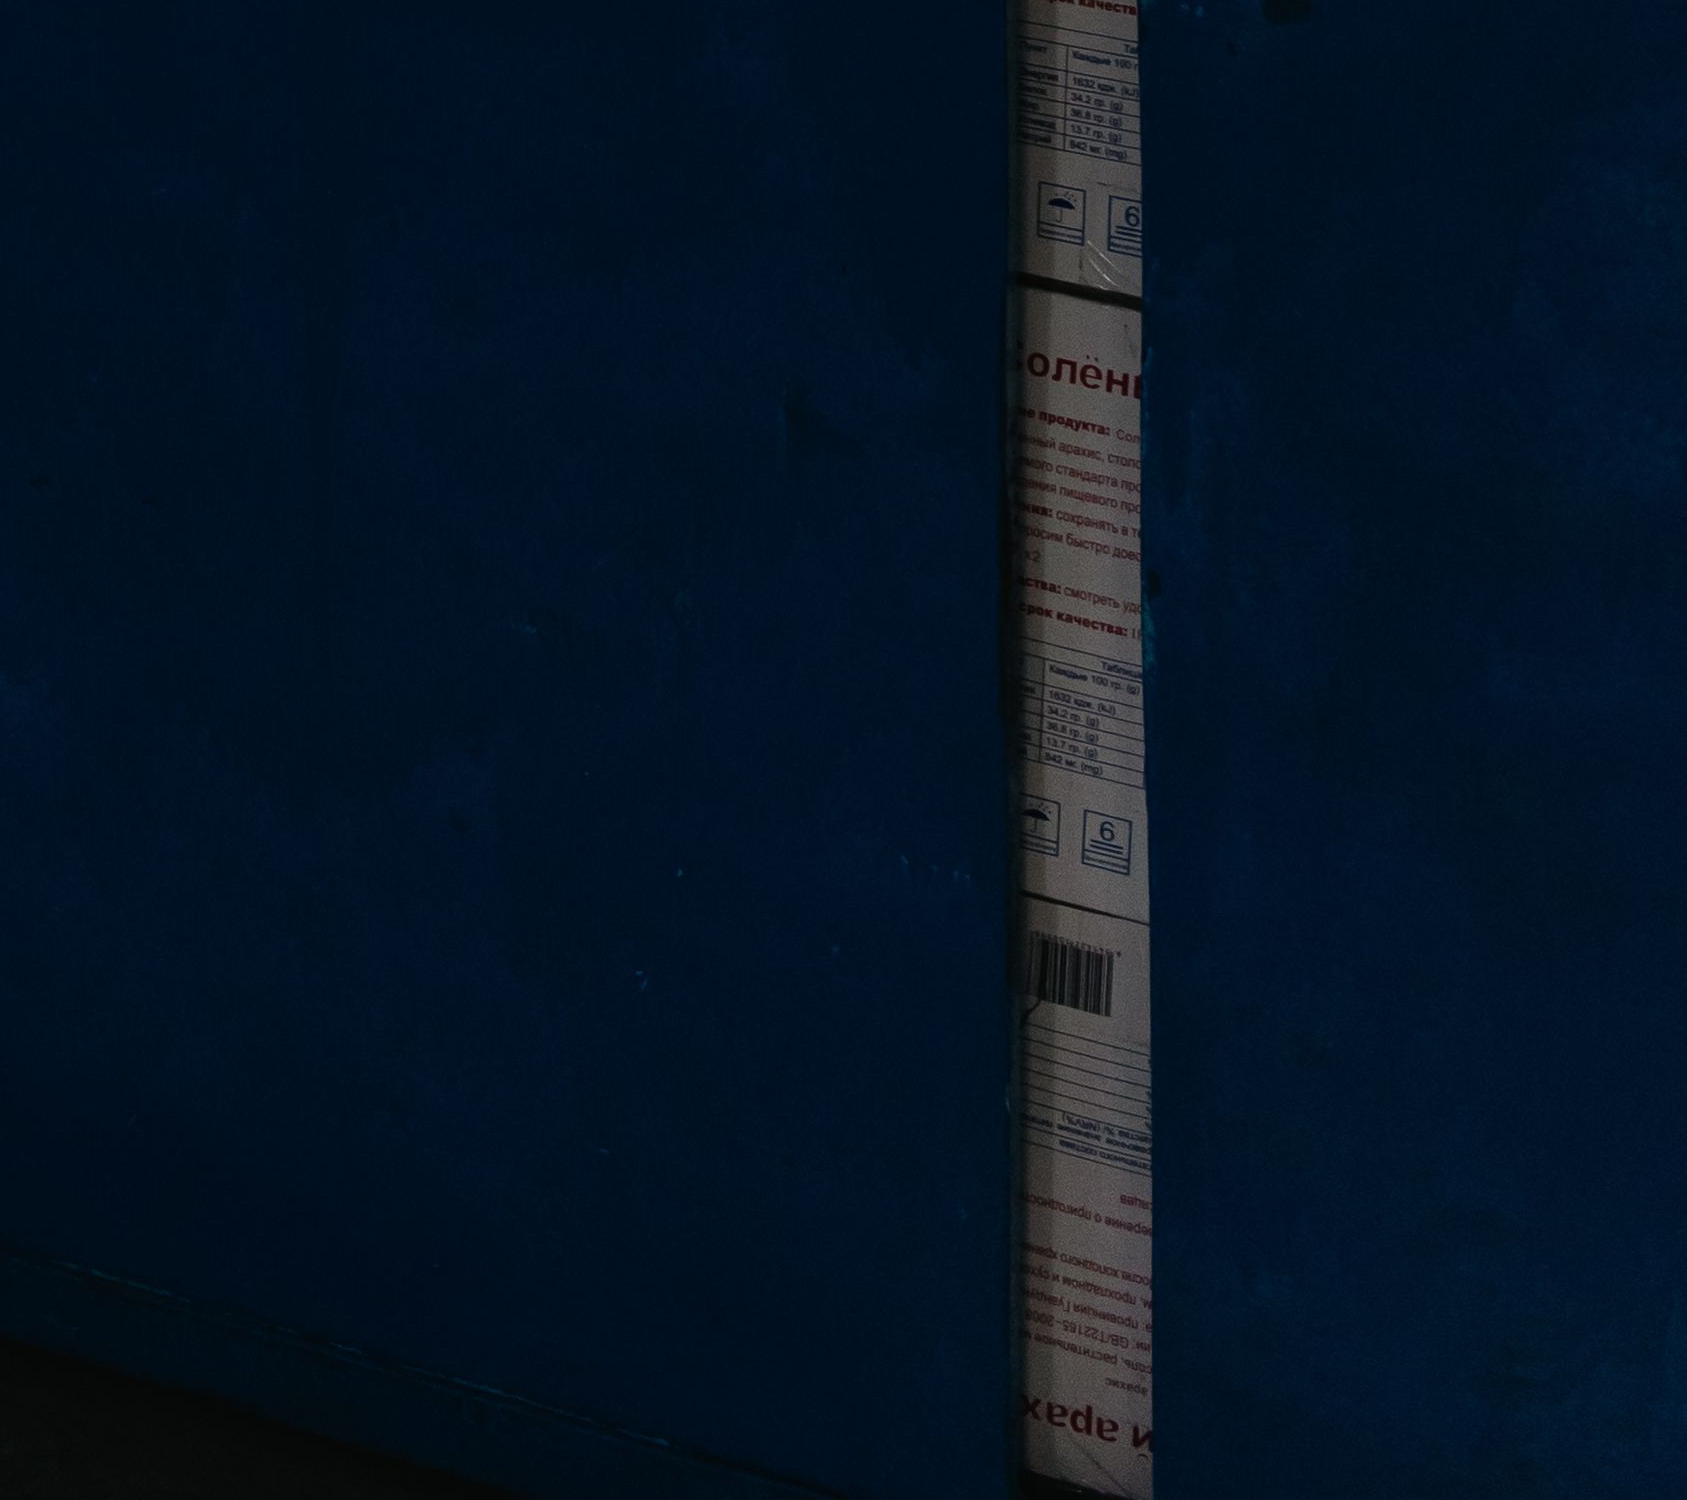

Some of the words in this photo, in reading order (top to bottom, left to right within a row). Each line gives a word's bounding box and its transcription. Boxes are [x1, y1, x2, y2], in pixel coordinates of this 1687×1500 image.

[1124, 205, 1140, 227] 6
[1039, 411, 1111, 437] продукта:
[1058, 441, 1105, 463] арахис,
[1056, 463, 1119, 487] стандарта
[1059, 486, 1118, 509] пищевого
[1056, 510, 1119, 535] сохранять
[1121, 526, 1129, 536] в
[1065, 532, 1111, 555] быстро
[1064, 586, 1121, 609] смотреть
[1056, 611, 1128, 637] качества:
[1091, 673, 1109, 687] 100
[1126, 682, 1140, 696] (g)
[1099, 821, 1115, 842] 6
[1094, 1213, 1103, 1224] о
[1060, 1252, 1120, 1279] холодного
[1053, 1273, 1060, 1282] и
[1062, 1276, 1137, 1306] прохладном
[1073, 1303, 1139, 1330] провинция
[1033, 1332, 1118, 1366] растительное
[1104, 1377, 1149, 1397] арахис
